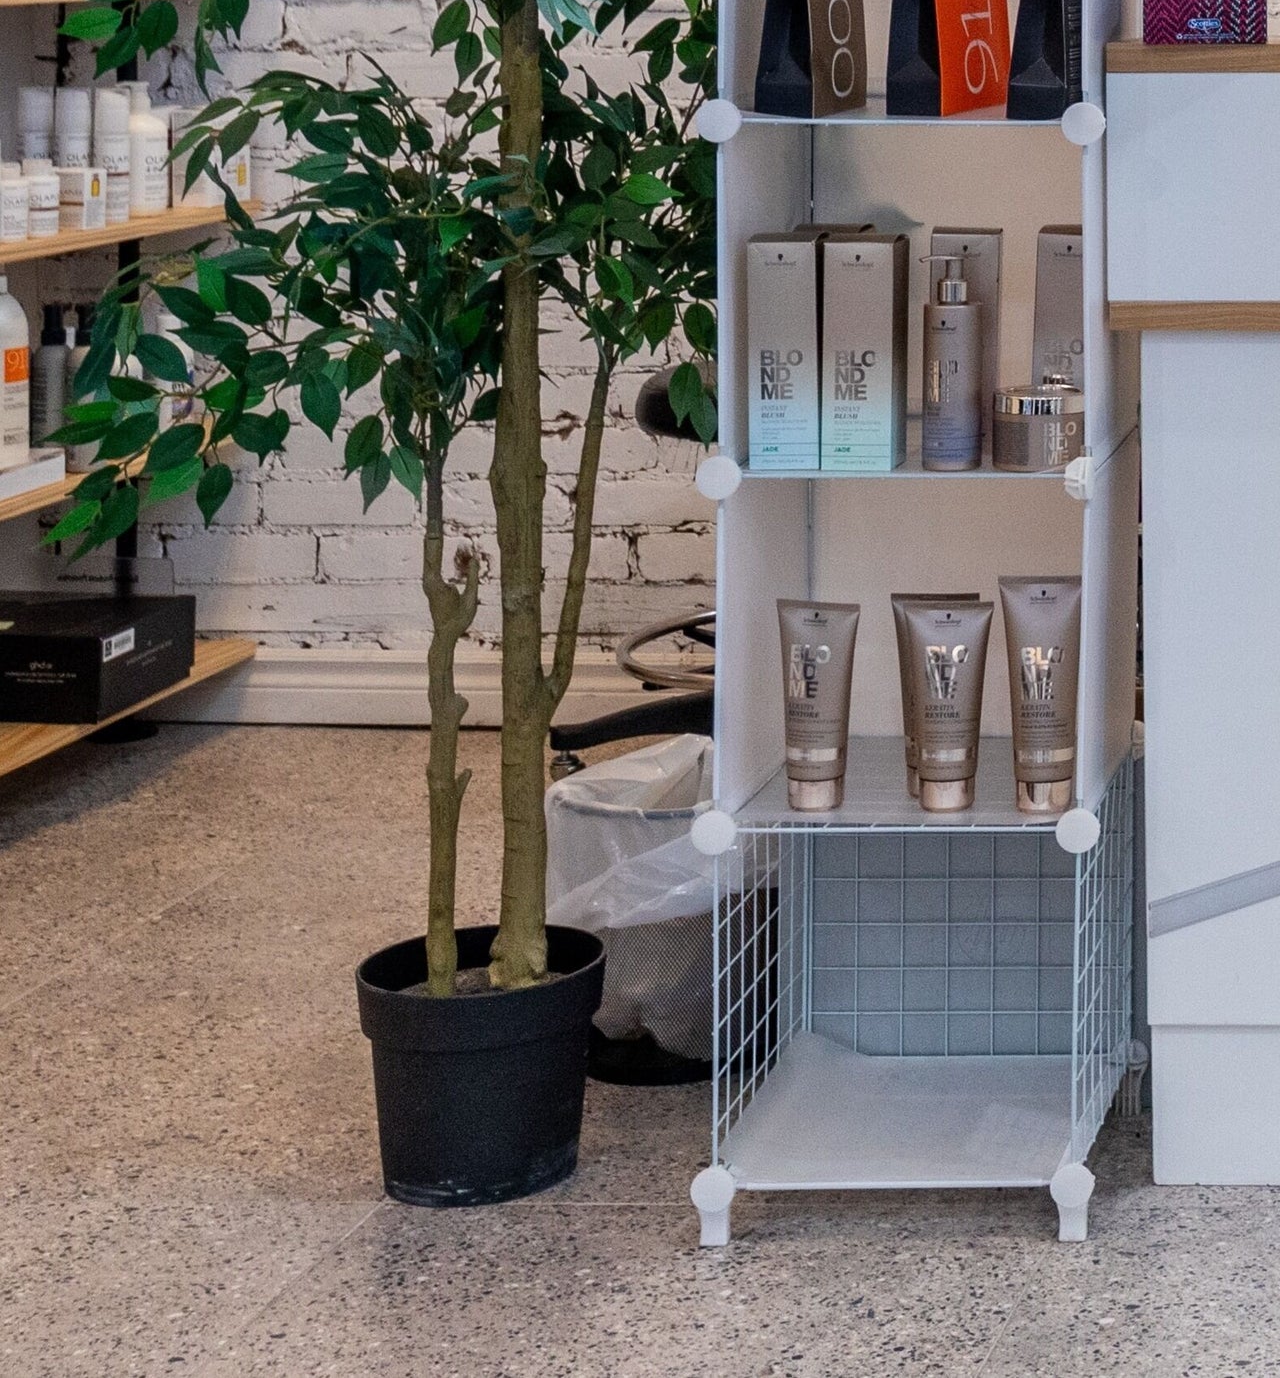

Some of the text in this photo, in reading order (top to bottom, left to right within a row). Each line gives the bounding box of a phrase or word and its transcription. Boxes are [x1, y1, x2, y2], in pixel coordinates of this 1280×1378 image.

[760, 350, 803, 367] BLO
[834, 350, 876, 367] BLO
[760, 367, 790, 383] ND
[834, 368, 865, 384] ND
[760, 384, 793, 400] ME
[834, 384, 867, 401] ME
[1044, 422, 1077, 437] BLO
[790, 644, 831, 664] BLO
[788, 680, 818, 699] ME
